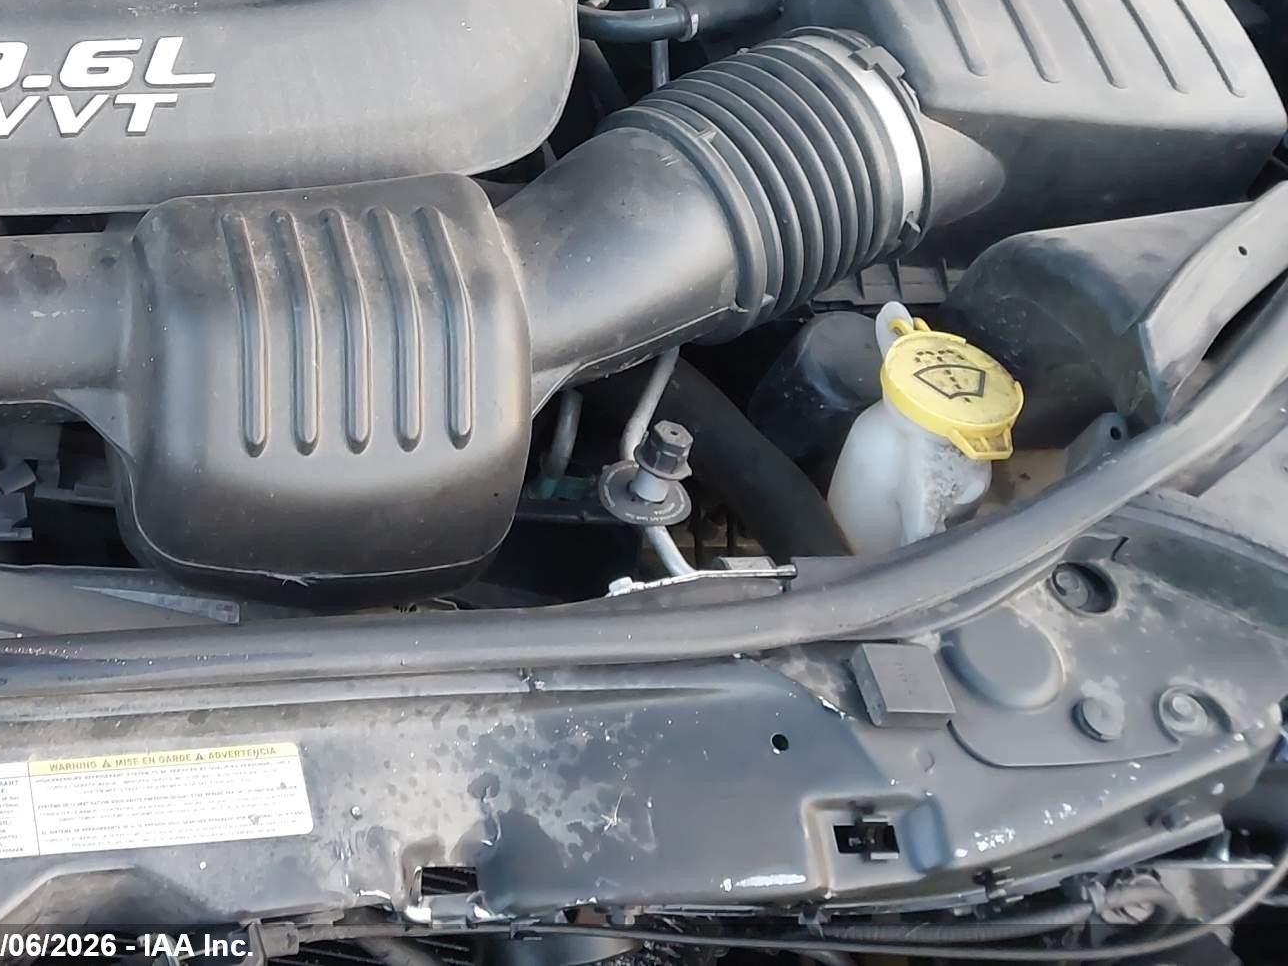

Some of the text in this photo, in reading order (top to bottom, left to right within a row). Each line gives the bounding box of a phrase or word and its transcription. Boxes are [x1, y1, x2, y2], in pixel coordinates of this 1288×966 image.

[49, 746, 277, 773] WARNING MISE EN GARDE ADVERTENCIA
